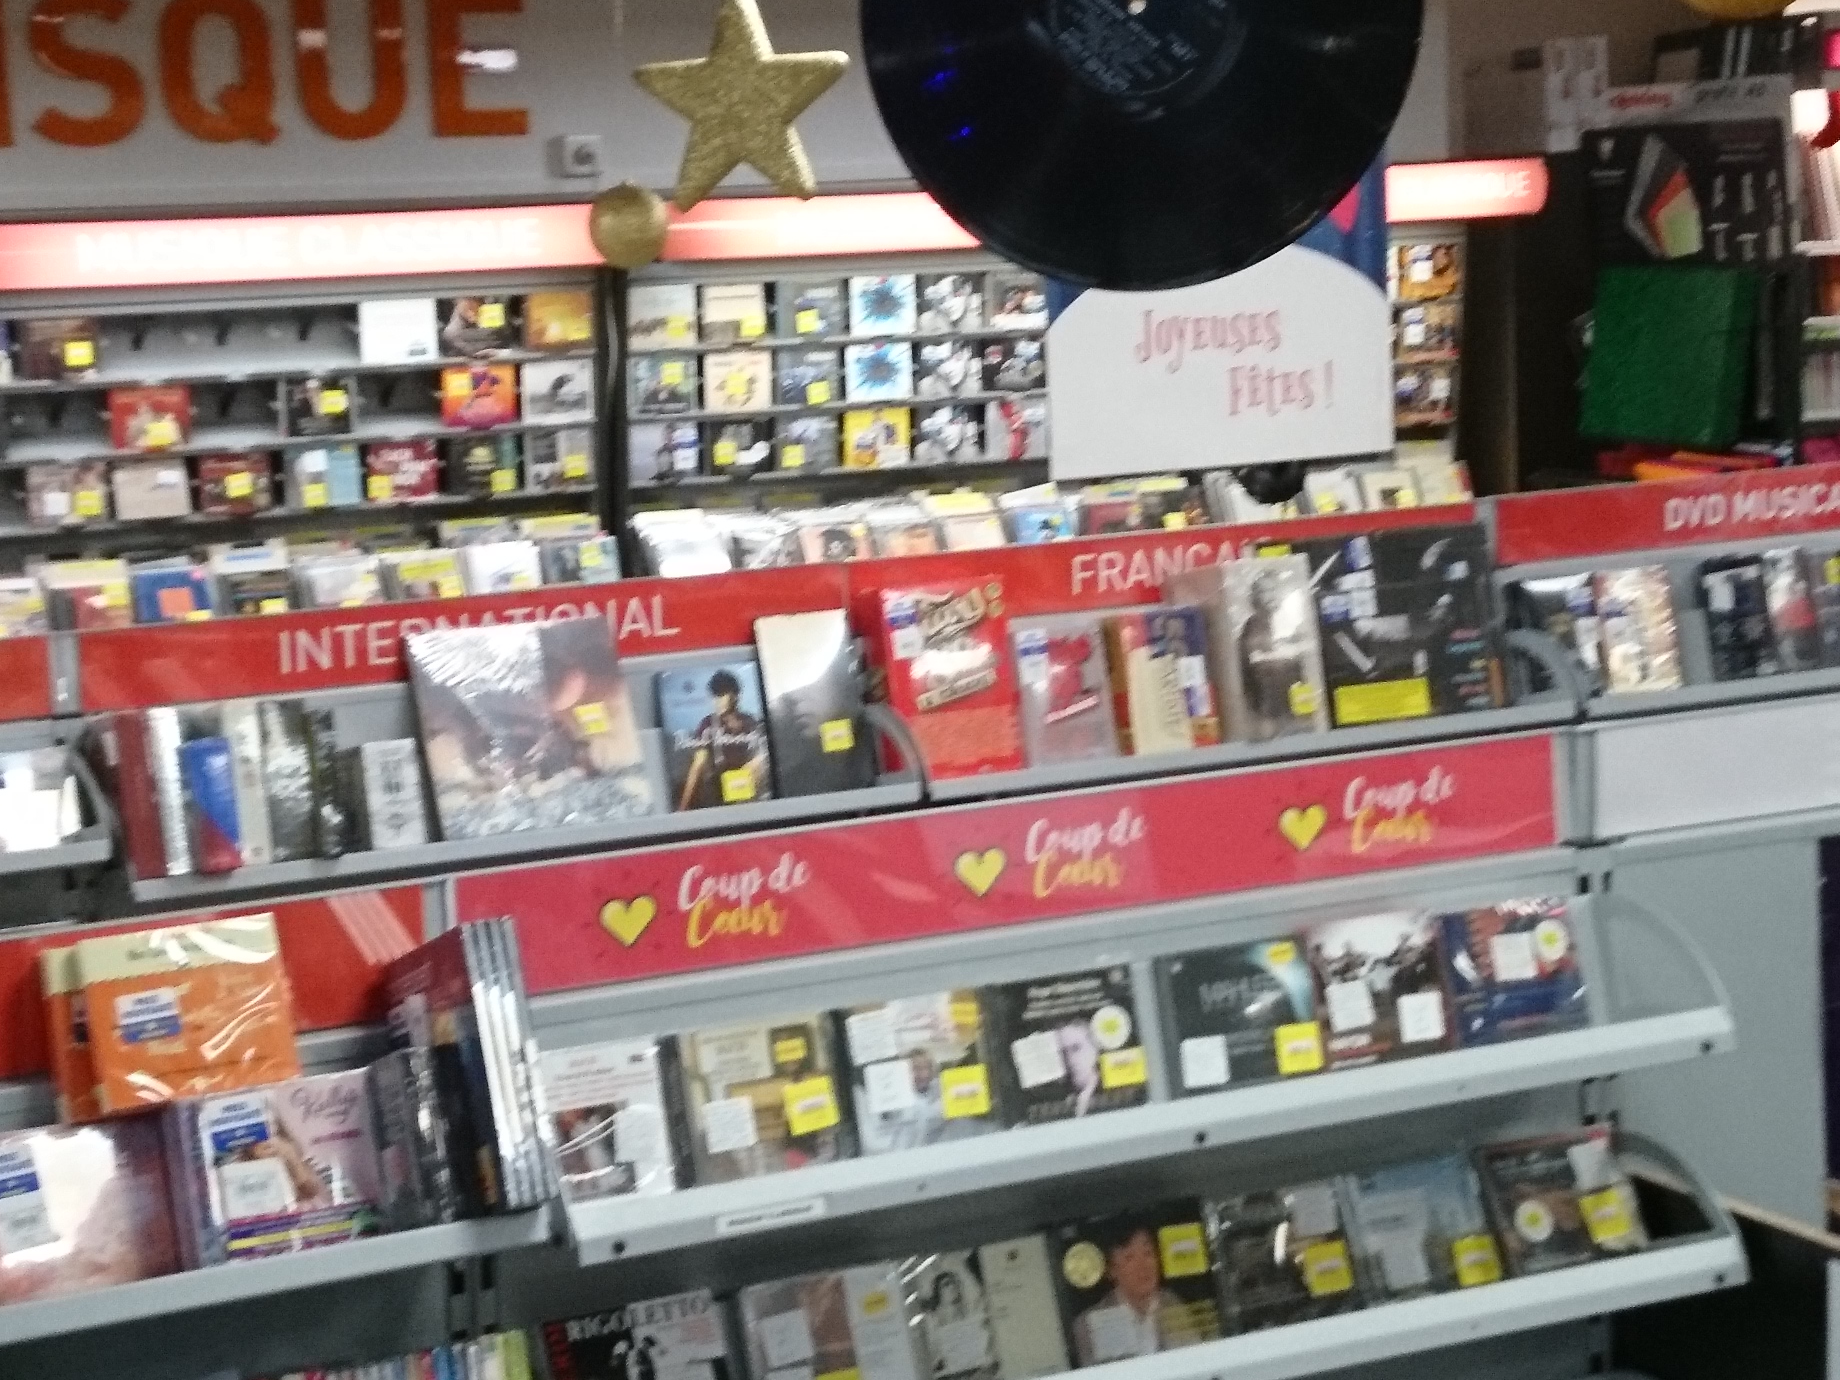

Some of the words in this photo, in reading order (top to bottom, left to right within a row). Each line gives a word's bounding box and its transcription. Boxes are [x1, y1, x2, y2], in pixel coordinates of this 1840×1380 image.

[1663, 496, 1725, 531] DVD
[1342, 774, 1417, 821] Coup
[1417, 763, 1457, 805] de
[1023, 815, 1105, 865] Coup
[1106, 806, 1146, 845] de
[676, 863, 765, 913] Coup
[766, 850, 813, 893] de
